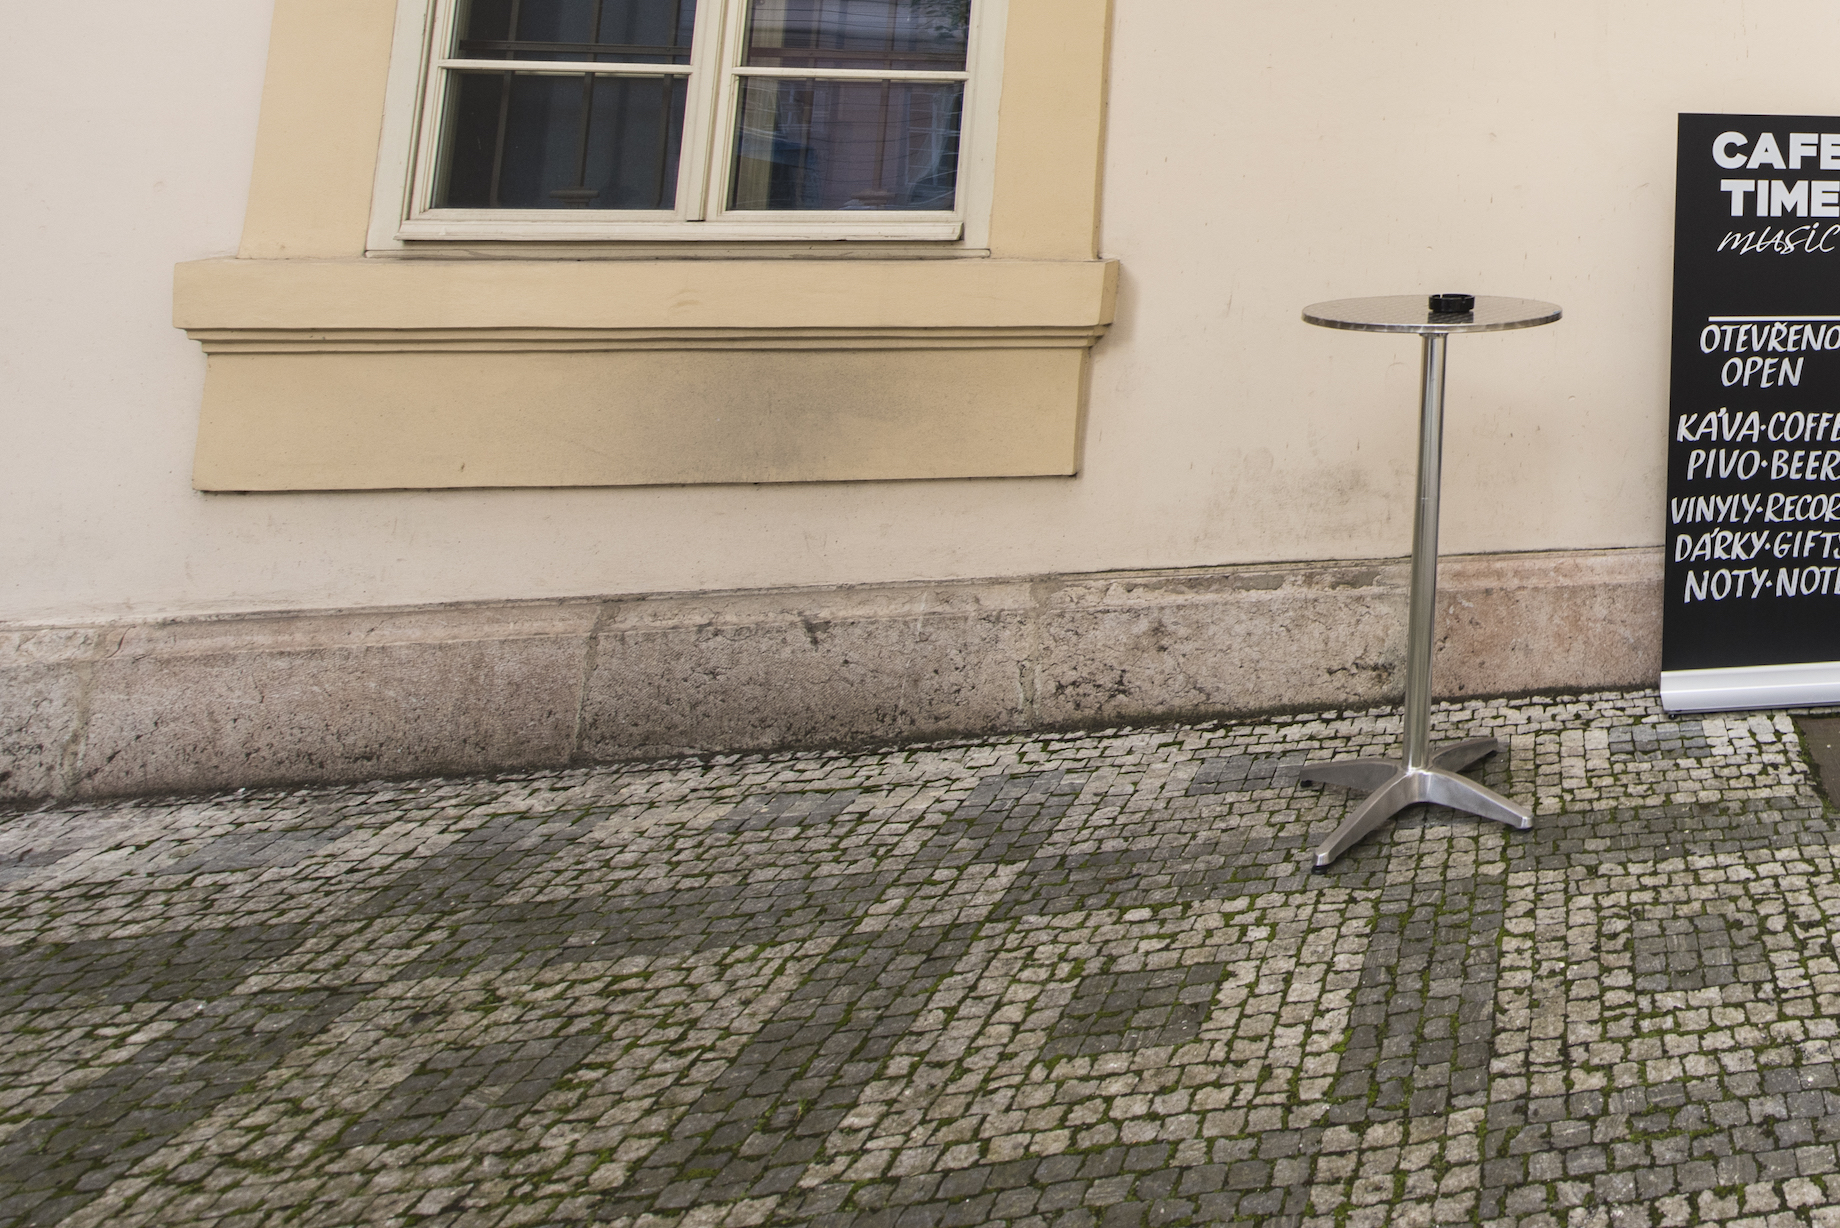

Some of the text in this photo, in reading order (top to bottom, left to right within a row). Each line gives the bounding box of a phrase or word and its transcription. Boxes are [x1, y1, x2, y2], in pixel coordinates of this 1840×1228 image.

[1720, 179, 1840, 217] TIME
[1717, 222, 1840, 255] music
[1721, 356, 1804, 388] OPEN
